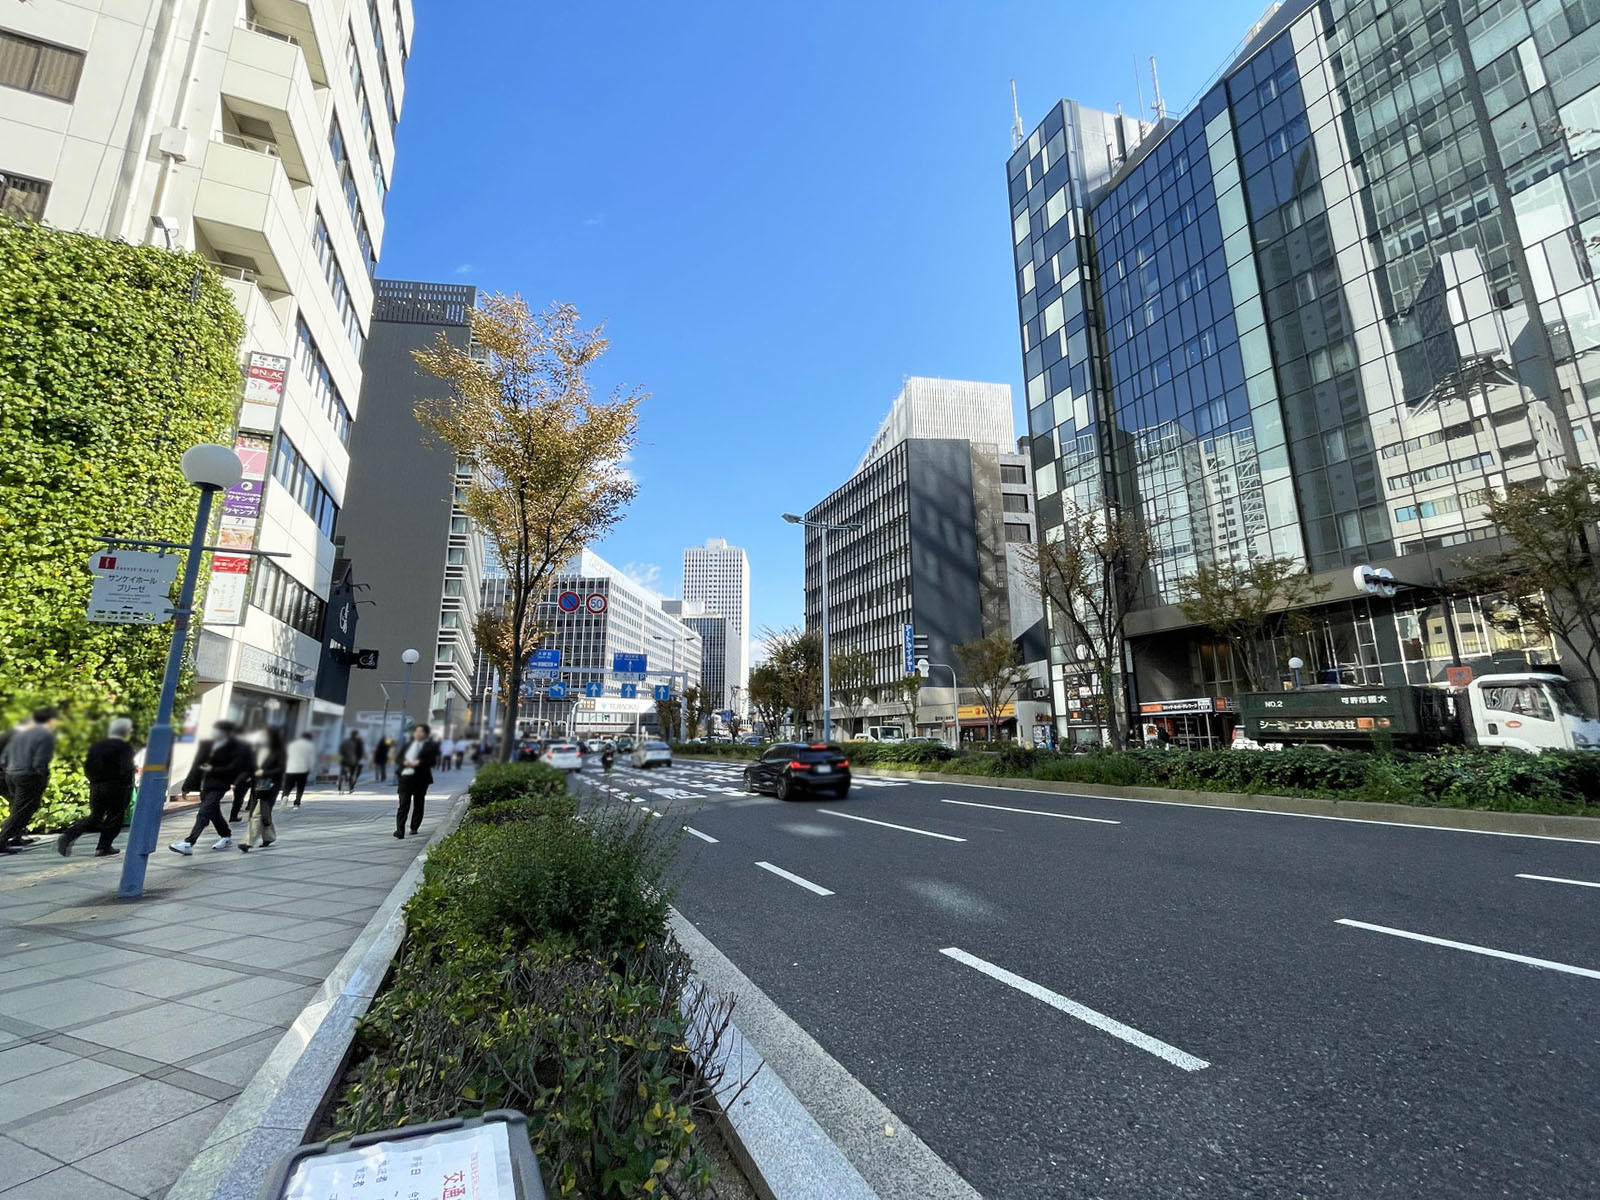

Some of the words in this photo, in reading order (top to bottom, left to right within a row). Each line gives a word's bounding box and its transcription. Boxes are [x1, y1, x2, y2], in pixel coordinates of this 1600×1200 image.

[109, 575, 157, 584] サンケイホール
[117, 584, 146, 593] ブリーゼ
[590, 599, 603, 609] 50
[905, 624, 913, 671] アートネイチャー
